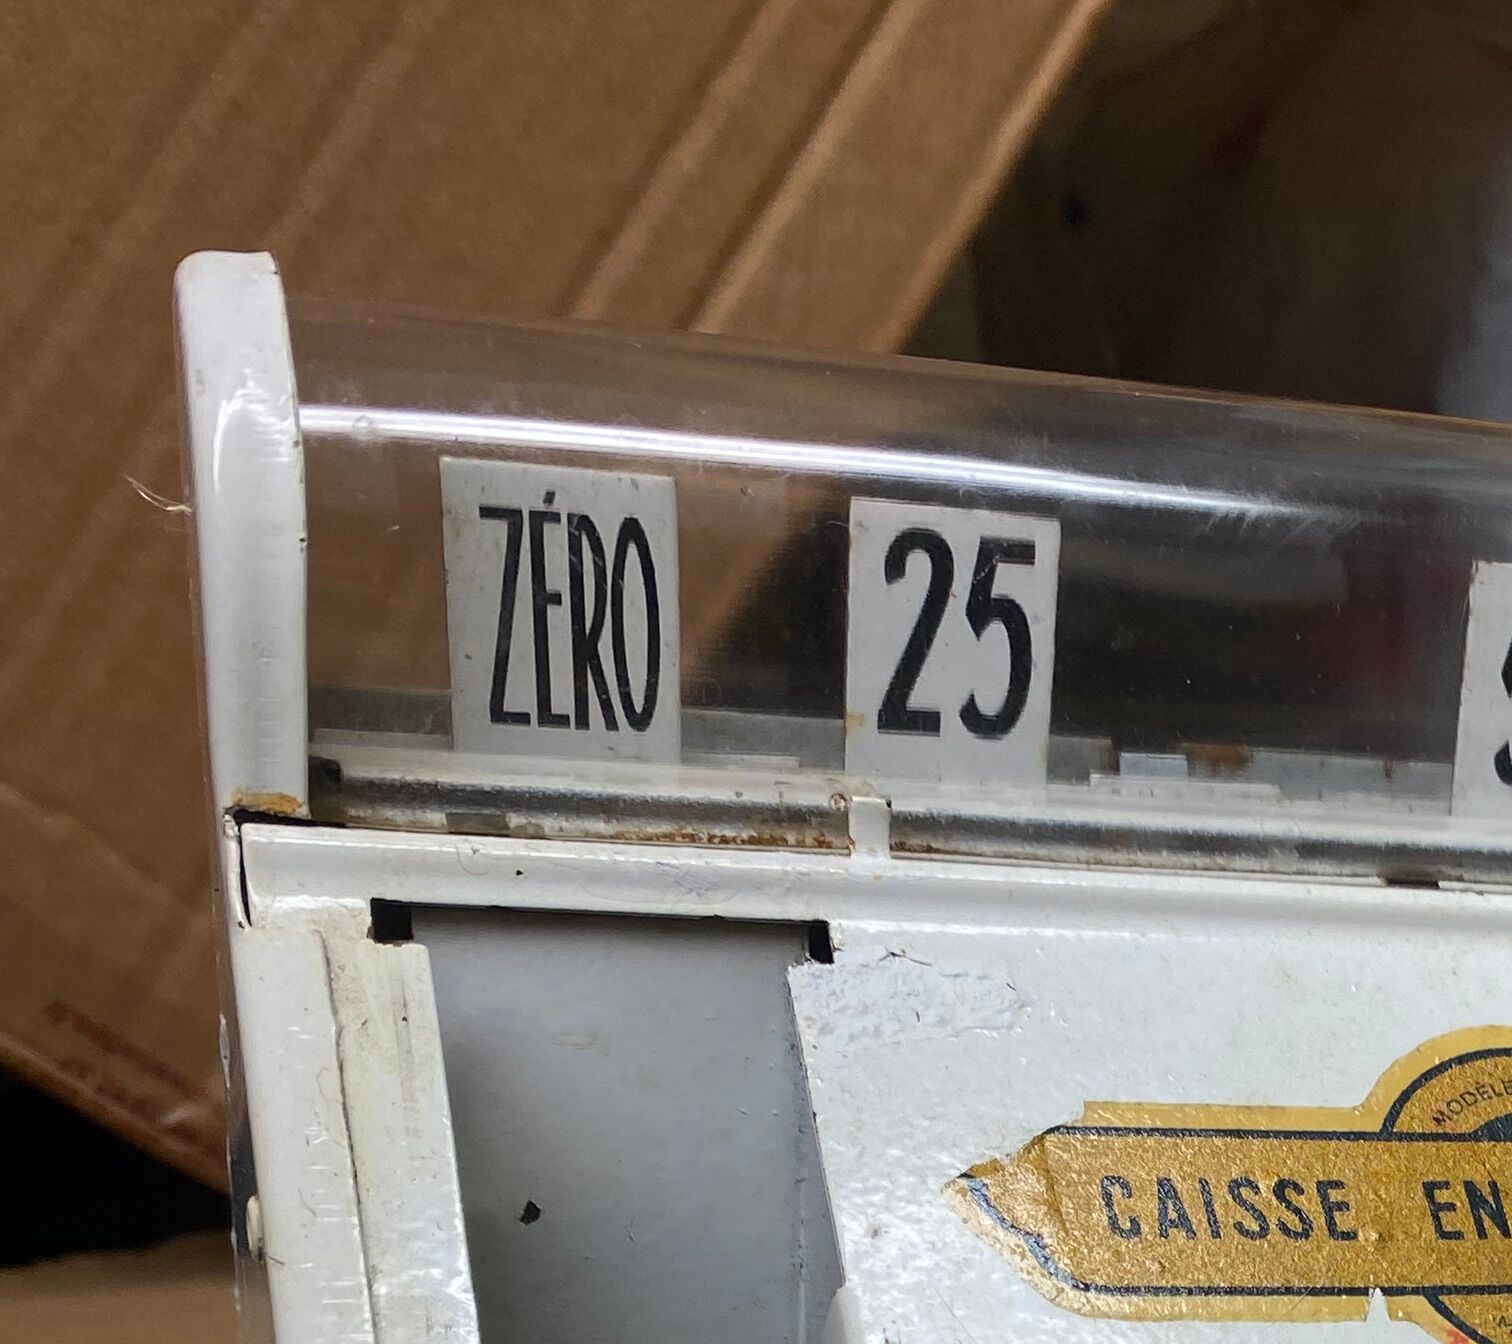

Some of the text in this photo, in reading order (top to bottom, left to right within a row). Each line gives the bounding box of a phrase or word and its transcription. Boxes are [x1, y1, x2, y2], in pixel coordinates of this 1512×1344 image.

[477, 490, 662, 734] ZÉRO
[876, 527, 1038, 739] 25
[1100, 1174, 1359, 1242] CAISSE
